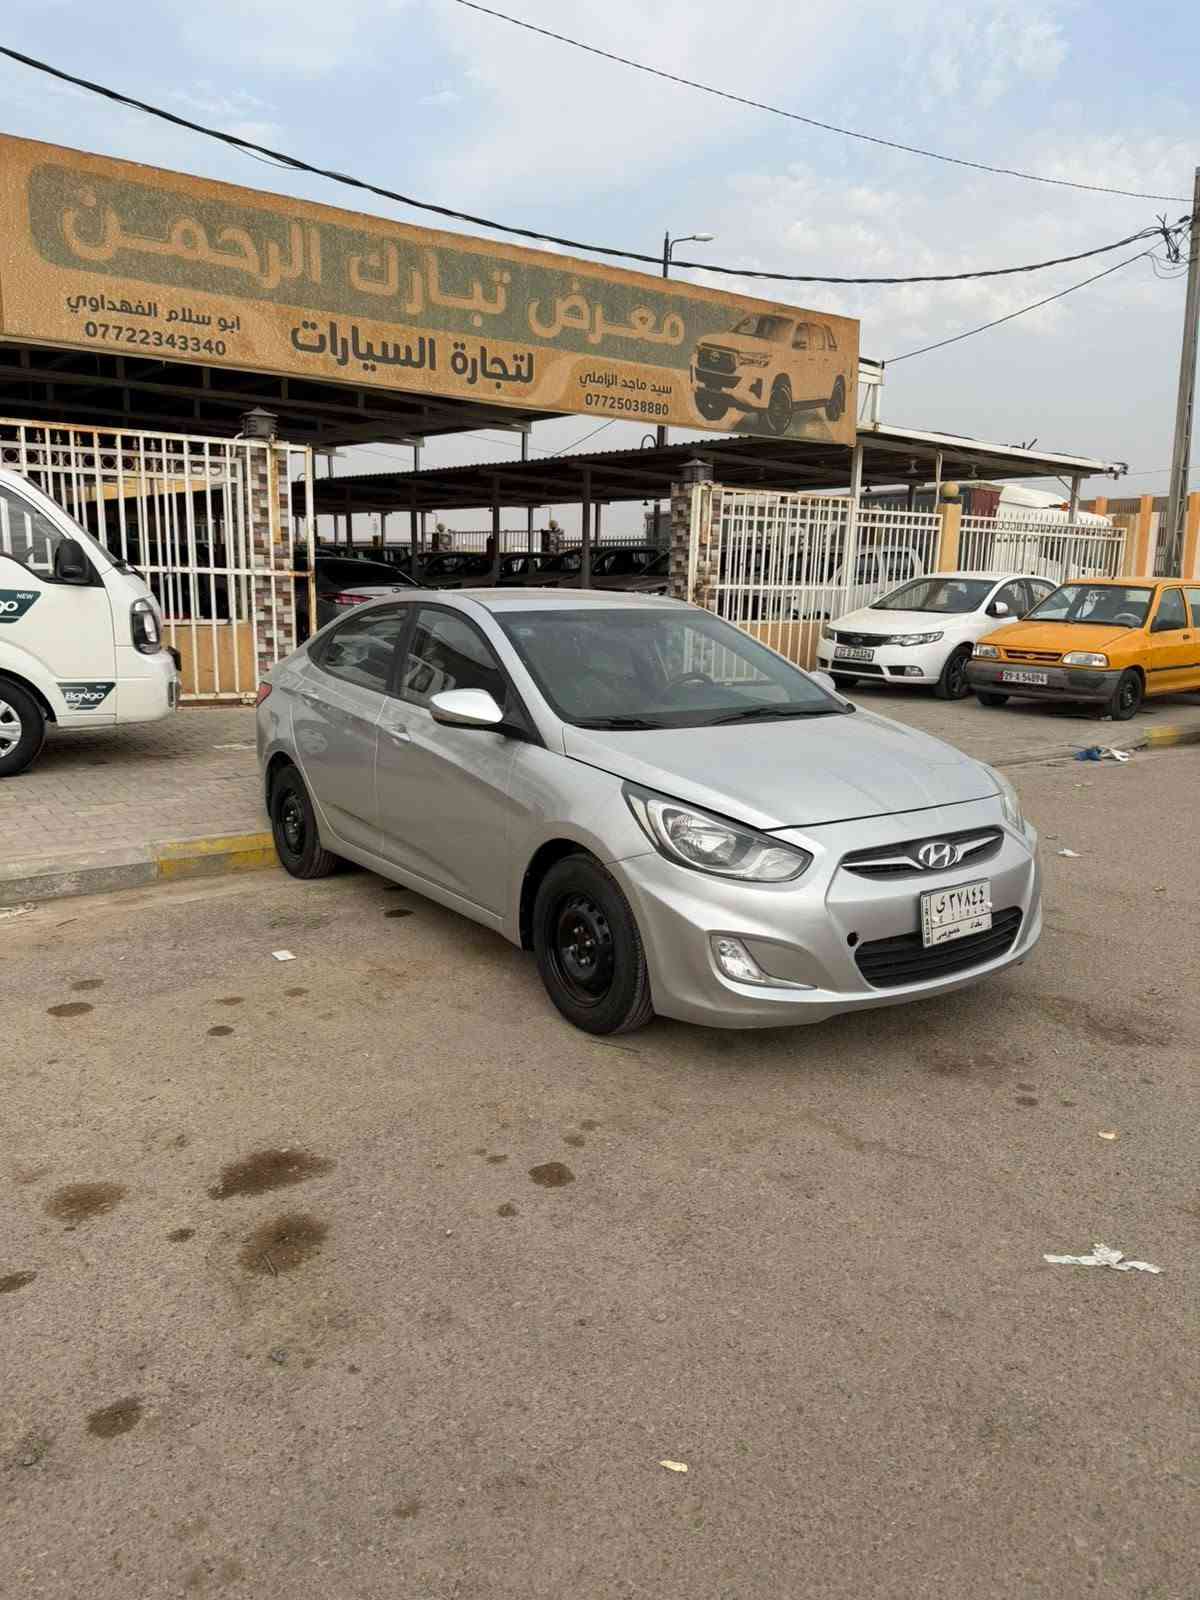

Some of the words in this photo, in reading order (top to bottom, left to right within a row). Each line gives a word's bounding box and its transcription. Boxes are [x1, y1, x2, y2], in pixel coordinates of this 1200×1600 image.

[62, 188, 321, 289] الرحمن
[350, 238, 511, 327] تبارك
[66, 294, 158, 317] الفهداوي
[166, 308, 212, 326] سلام
[528, 279, 686, 346] معرض
[85, 321, 226, 356] 07722343340
[218, 316, 241, 333] ابو
[291, 321, 436, 372] السيارات
[451, 341, 534, 389] لتجارة
[621, 378, 646, 392] ماجد
[650, 385, 672, 396] سيد
[585, 393, 669, 416] 07725038880
